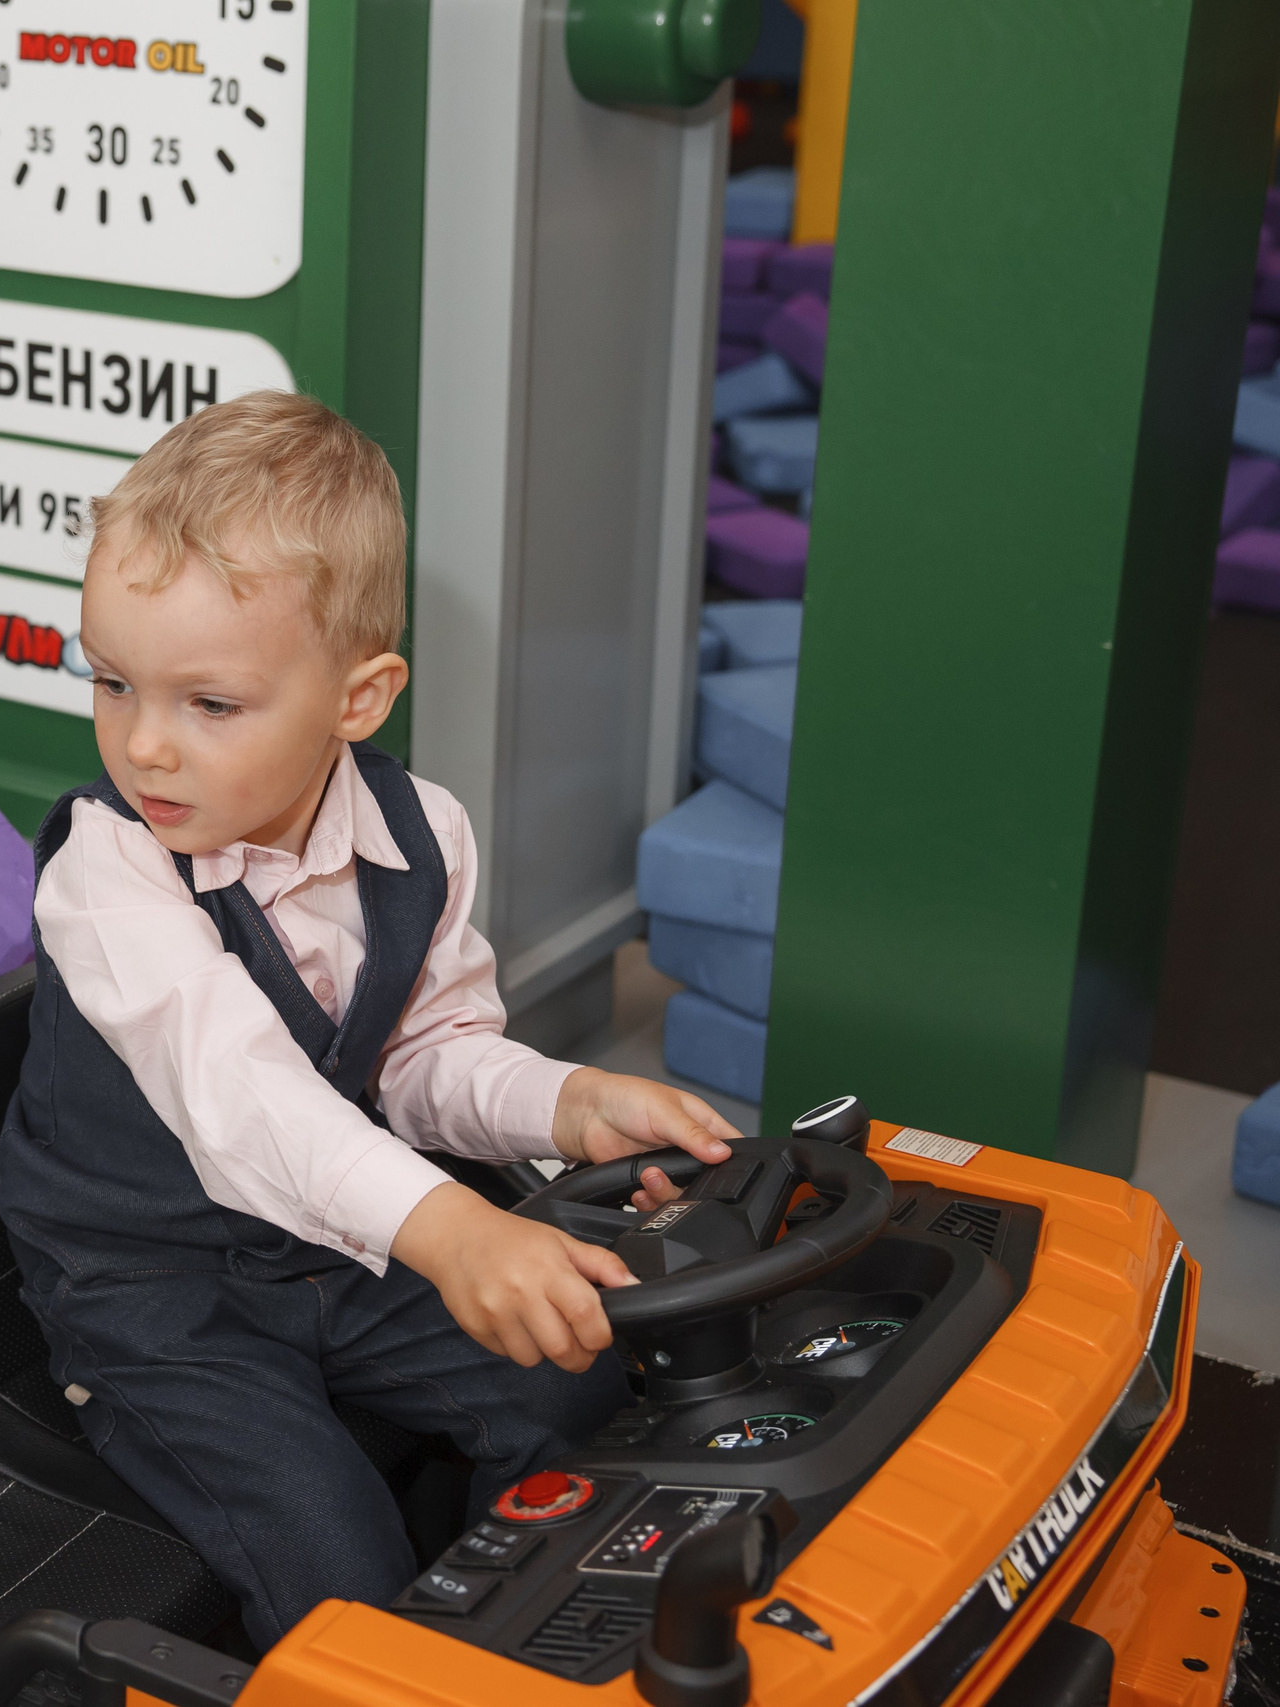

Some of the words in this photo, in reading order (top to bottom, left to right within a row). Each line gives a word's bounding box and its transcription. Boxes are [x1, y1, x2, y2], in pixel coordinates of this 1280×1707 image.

[19, 31, 137, 69] MOTOR
[146, 41, 205, 74] OIL
[210, 78, 240, 105] 20
[26, 127, 55, 154] 35
[87, 124, 128, 166] 30
[151, 138, 181, 165] 25
[39, 492, 81, 537] 95
